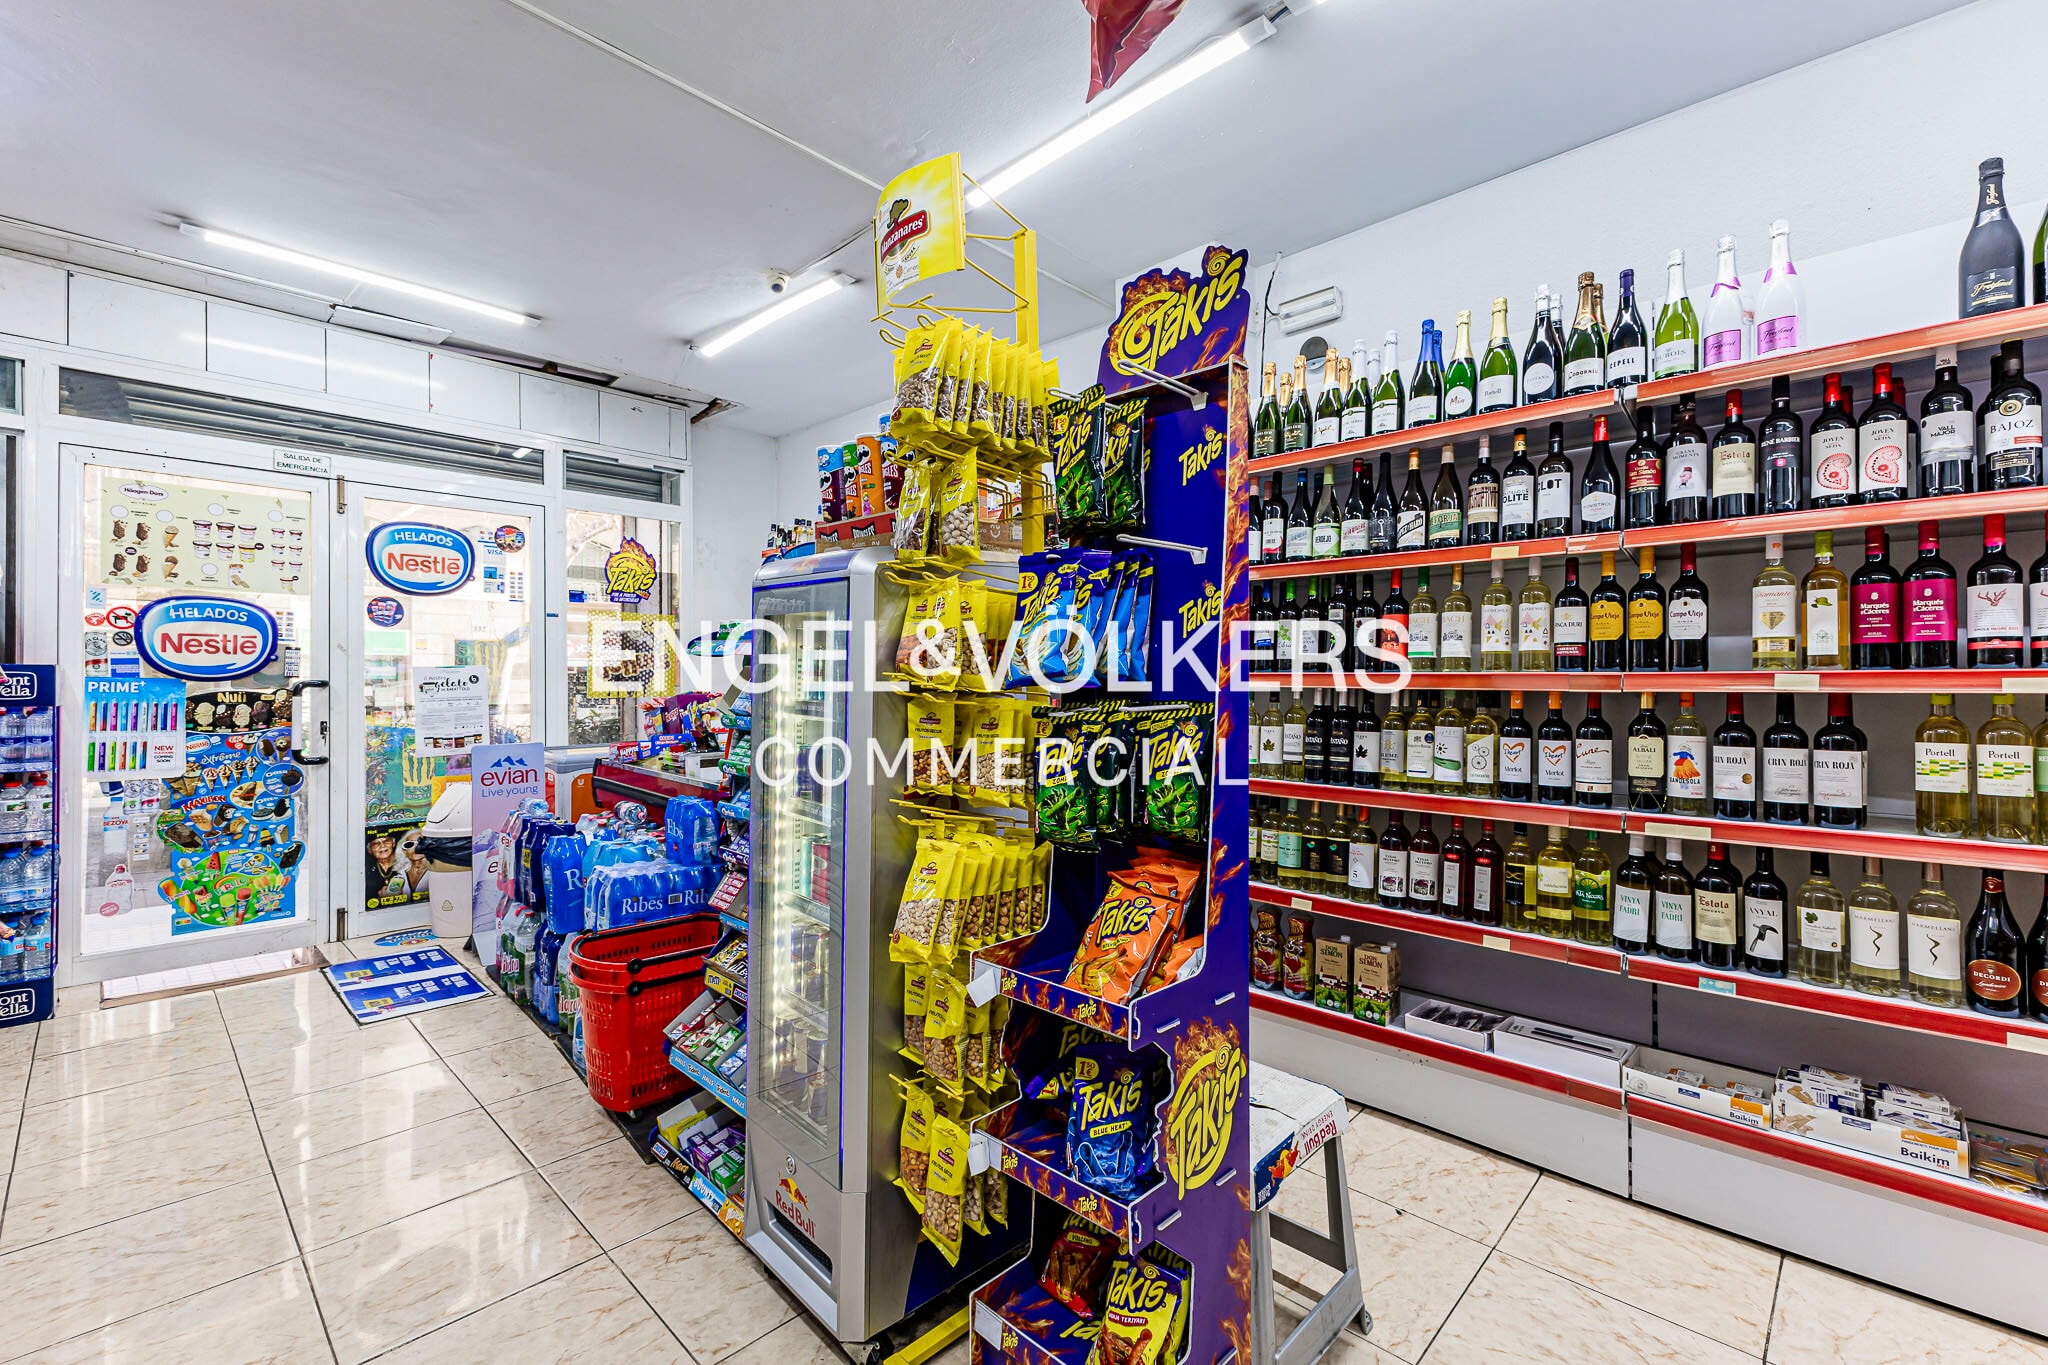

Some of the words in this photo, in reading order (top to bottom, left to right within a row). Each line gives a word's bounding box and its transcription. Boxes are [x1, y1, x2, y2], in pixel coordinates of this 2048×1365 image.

[1140, 254, 1243, 375] Takis
[1609, 357, 1636, 369] CEPELL
[1990, 419, 2035, 434] BAJOZ
[1775, 436, 1800, 444] BARBIER
[1930, 430, 1956, 439] MAJOR
[1054, 414, 1093, 476] Takis
[283, 453, 311, 462] SALIDA
[1178, 431, 1223, 487] Takis
[1719, 450, 1751, 461] Estola
[276, 461, 329, 474] EMERGENCIA
[394, 531, 453, 548] HELADOS
[606, 567, 656, 594] Takis
[1754, 590, 1793, 599] Diamante
[1020, 576, 1062, 627] Takis
[1860, 602, 1890, 610] Marqués
[1912, 599, 1944, 607] Marqués
[1915, 604, 1945, 612] Cáceres
[169, 606, 249, 622] HELADOS
[1178, 588, 1223, 639] Takis
[1604, 611, 1620, 620] Viejo
[1643, 610, 1660, 618] Viejo
[1669, 611, 1688, 619] Campo
[1687, 609, 1704, 618] Viejo
[217, 692, 247, 703] Nuii
[1036, 735, 1088, 783] Takis
[1148, 731, 1204, 777] Takis
[1925, 748, 1956, 757] Portell
[1988, 750, 2021, 760] Portell
[1727, 756, 1748, 765] ROJA
[1767, 758, 1787, 766] CRIN
[1832, 761, 1855, 770] ROJA
[480, 767, 539, 787] evian
[1544, 769, 1565, 777] Merlot
[481, 788, 504, 798] Live
[504, 785, 539, 798] young
[182, 795, 227, 813] MAXIBON
[621, 895, 663, 915] Ribes
[1620, 894, 1641, 905] VINYA
[1661, 901, 1683, 911] VINYA
[1698, 894, 1730, 909] Estola
[1096, 897, 1152, 947] Takis
[1320, 948, 1343, 959] SIMON
[1325, 944, 1338, 952] DON
[1359, 958, 1383, 969] SIMON
[1973, 970, 2011, 983] DECORDI
[1001, 974, 1018, 993] Takis
[0, 992, 29, 1005] ont
[0, 1003, 29, 1017] ella
[1077, 1000, 1097, 1021] Takis
[1079, 1073, 1143, 1132] Takis
[1170, 1042, 1243, 1201] Takis
[1729, 1111, 1760, 1126] Baikim
[1092, 1128, 1109, 1136] BLUE
[1110, 1124, 1126, 1133] HEAT
[1318, 1119, 1338, 1144] Red
[1304, 1135, 1321, 1156] Bull
[1001, 1154, 1019, 1171] Takis
[1900, 1147, 1950, 1167] Baikim
[1078, 1192, 1098, 1213] Takis
[775, 1190, 795, 1220] Red
[795, 1210, 816, 1239] Bull
[1071, 1234, 1093, 1245] VOLCANO
[1108, 1260, 1168, 1310] Takis
[1121, 1316, 1146, 1325] TERIYAKI
[1002, 1332, 1019, 1349] Takis
